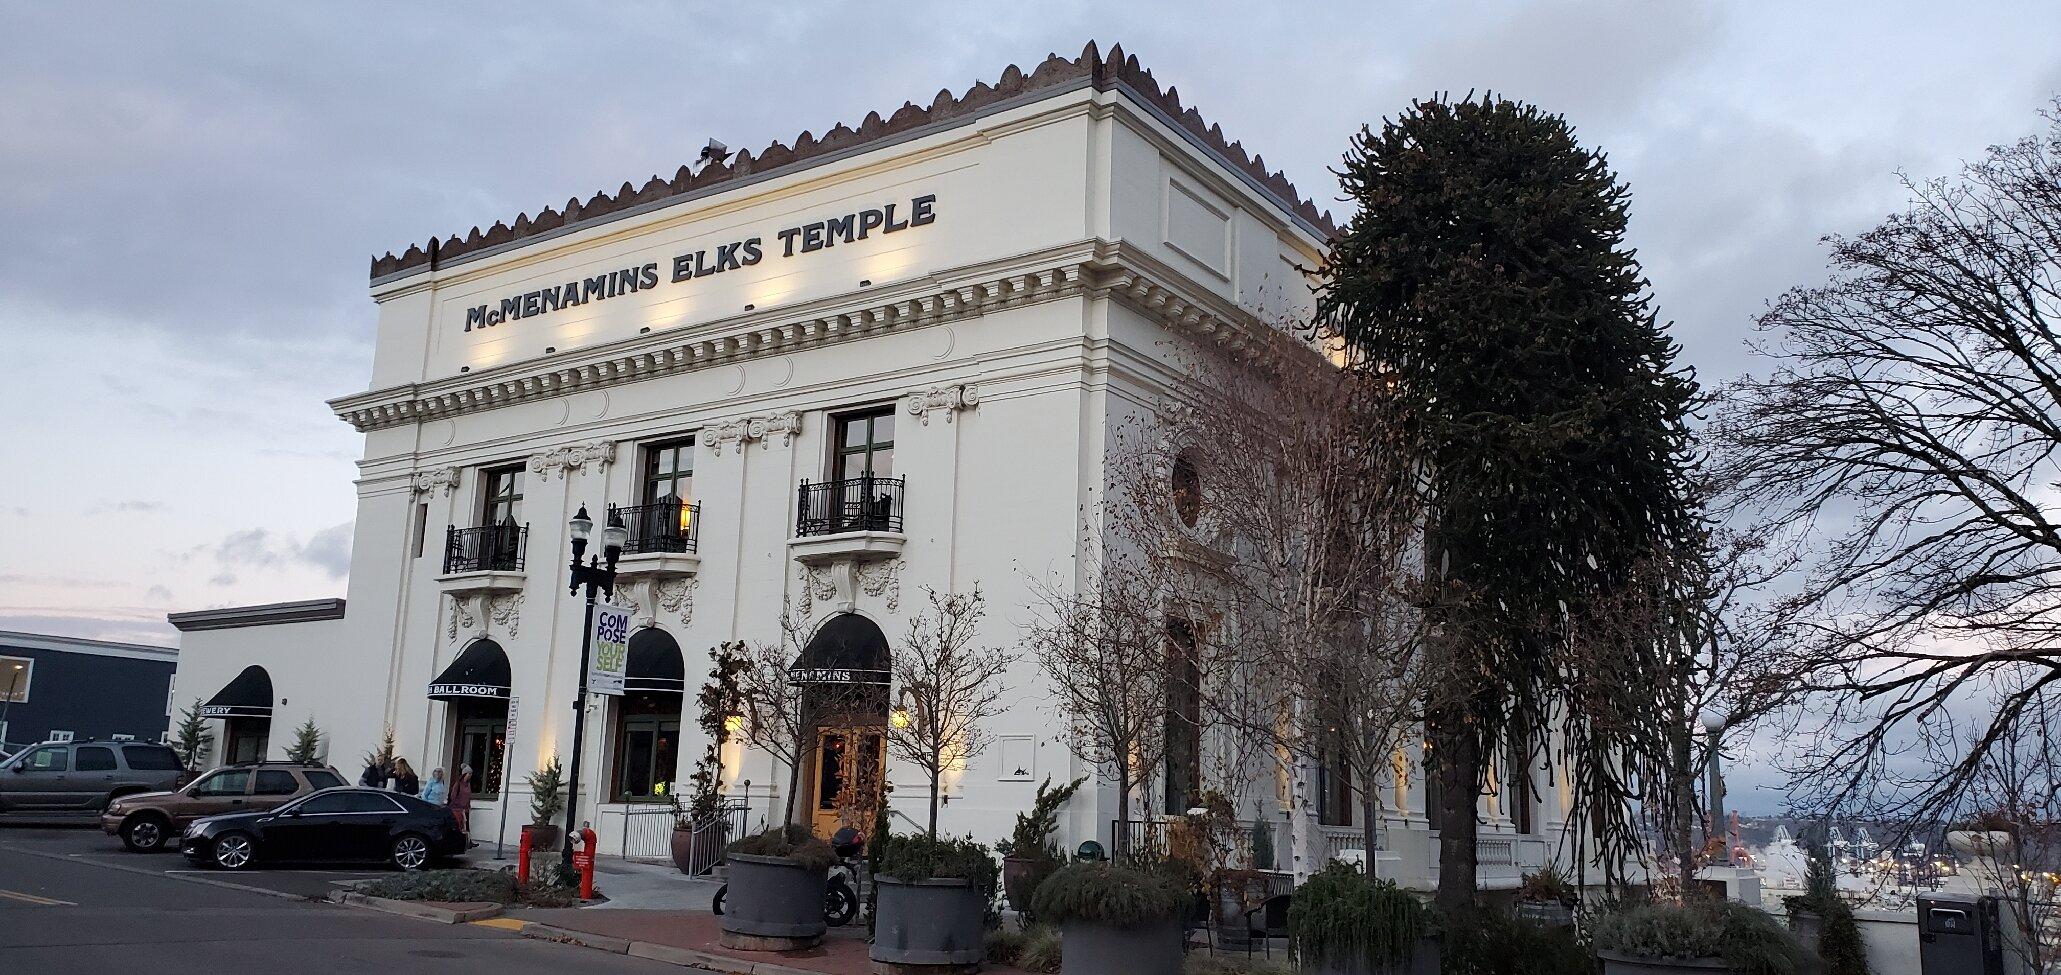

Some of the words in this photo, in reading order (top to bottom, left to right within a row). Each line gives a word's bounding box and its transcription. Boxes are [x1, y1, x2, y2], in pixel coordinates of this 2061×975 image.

[464, 263, 658, 332] McMENAMINS
[671, 237, 763, 284] ELKS
[778, 193, 937, 258] TEMPLE
[600, 612, 628, 630] COM
[597, 626, 625, 644] POSE
[597, 641, 625, 659] YOUR
[596, 656, 622, 672] SELF
[434, 685, 498, 695] BALLROOM
